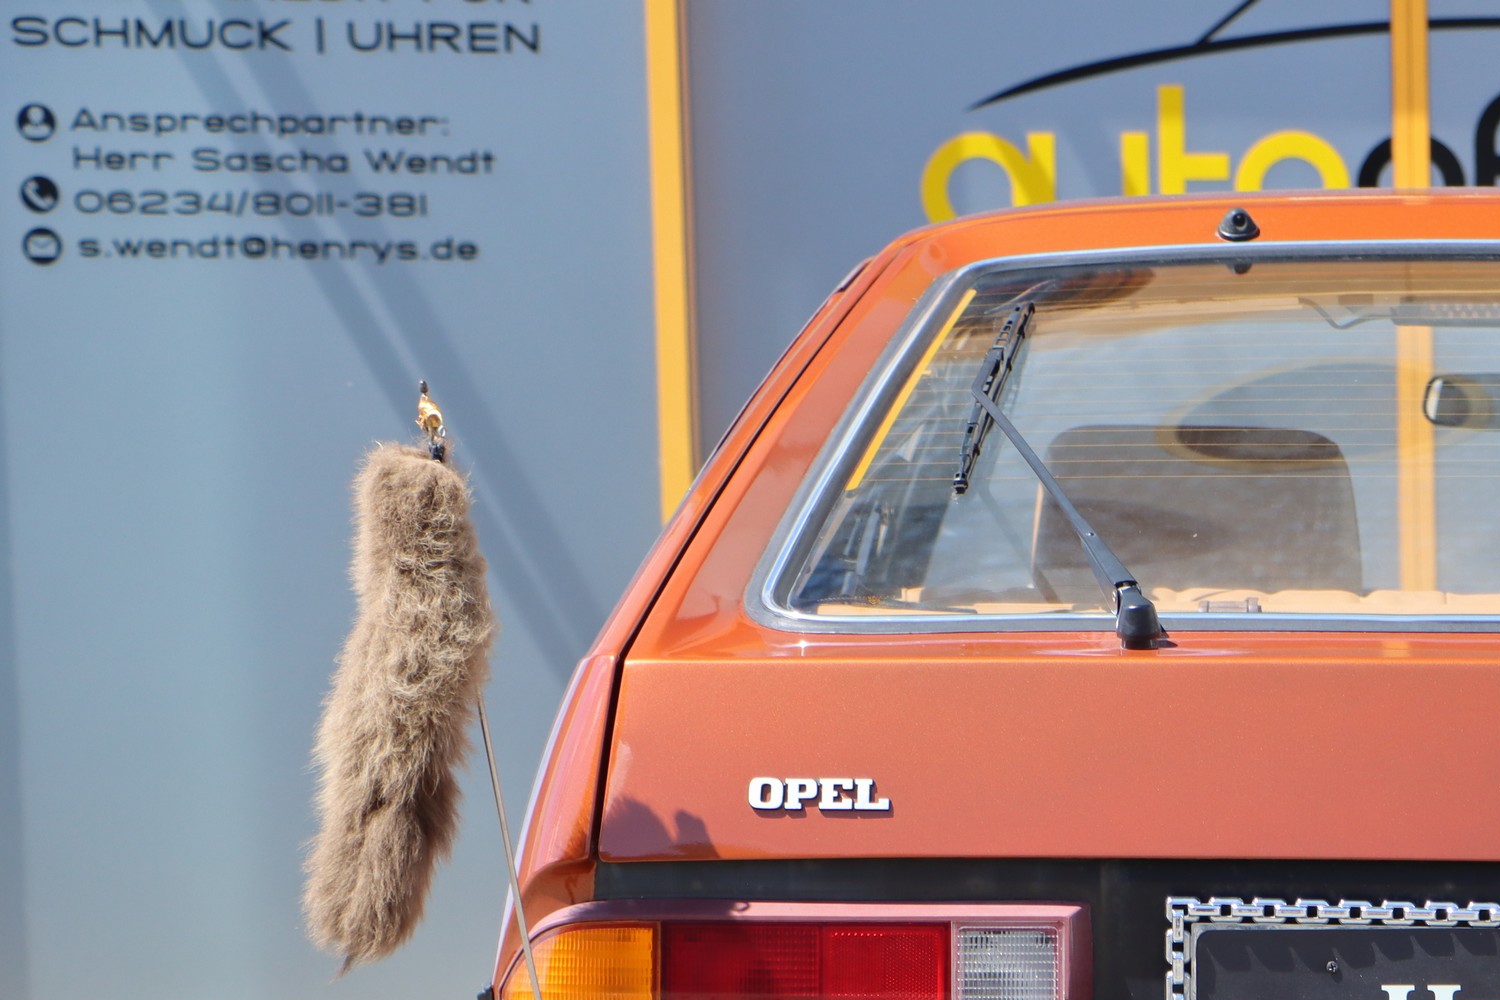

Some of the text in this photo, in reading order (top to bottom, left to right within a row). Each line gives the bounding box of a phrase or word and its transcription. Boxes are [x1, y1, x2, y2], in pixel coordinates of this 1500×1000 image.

[9, 15, 294, 51] SCHMUCK
[345, 20, 542, 54] UHREN
[69, 107, 450, 137] Ansprechpartner:
[71, 146, 497, 175] Herr Sascha Wendt
[72, 189, 429, 218] 06234/8011-381
[76, 234, 481, 266] s.wendt@henrys.de
[748, 777, 891, 811] OPEL
